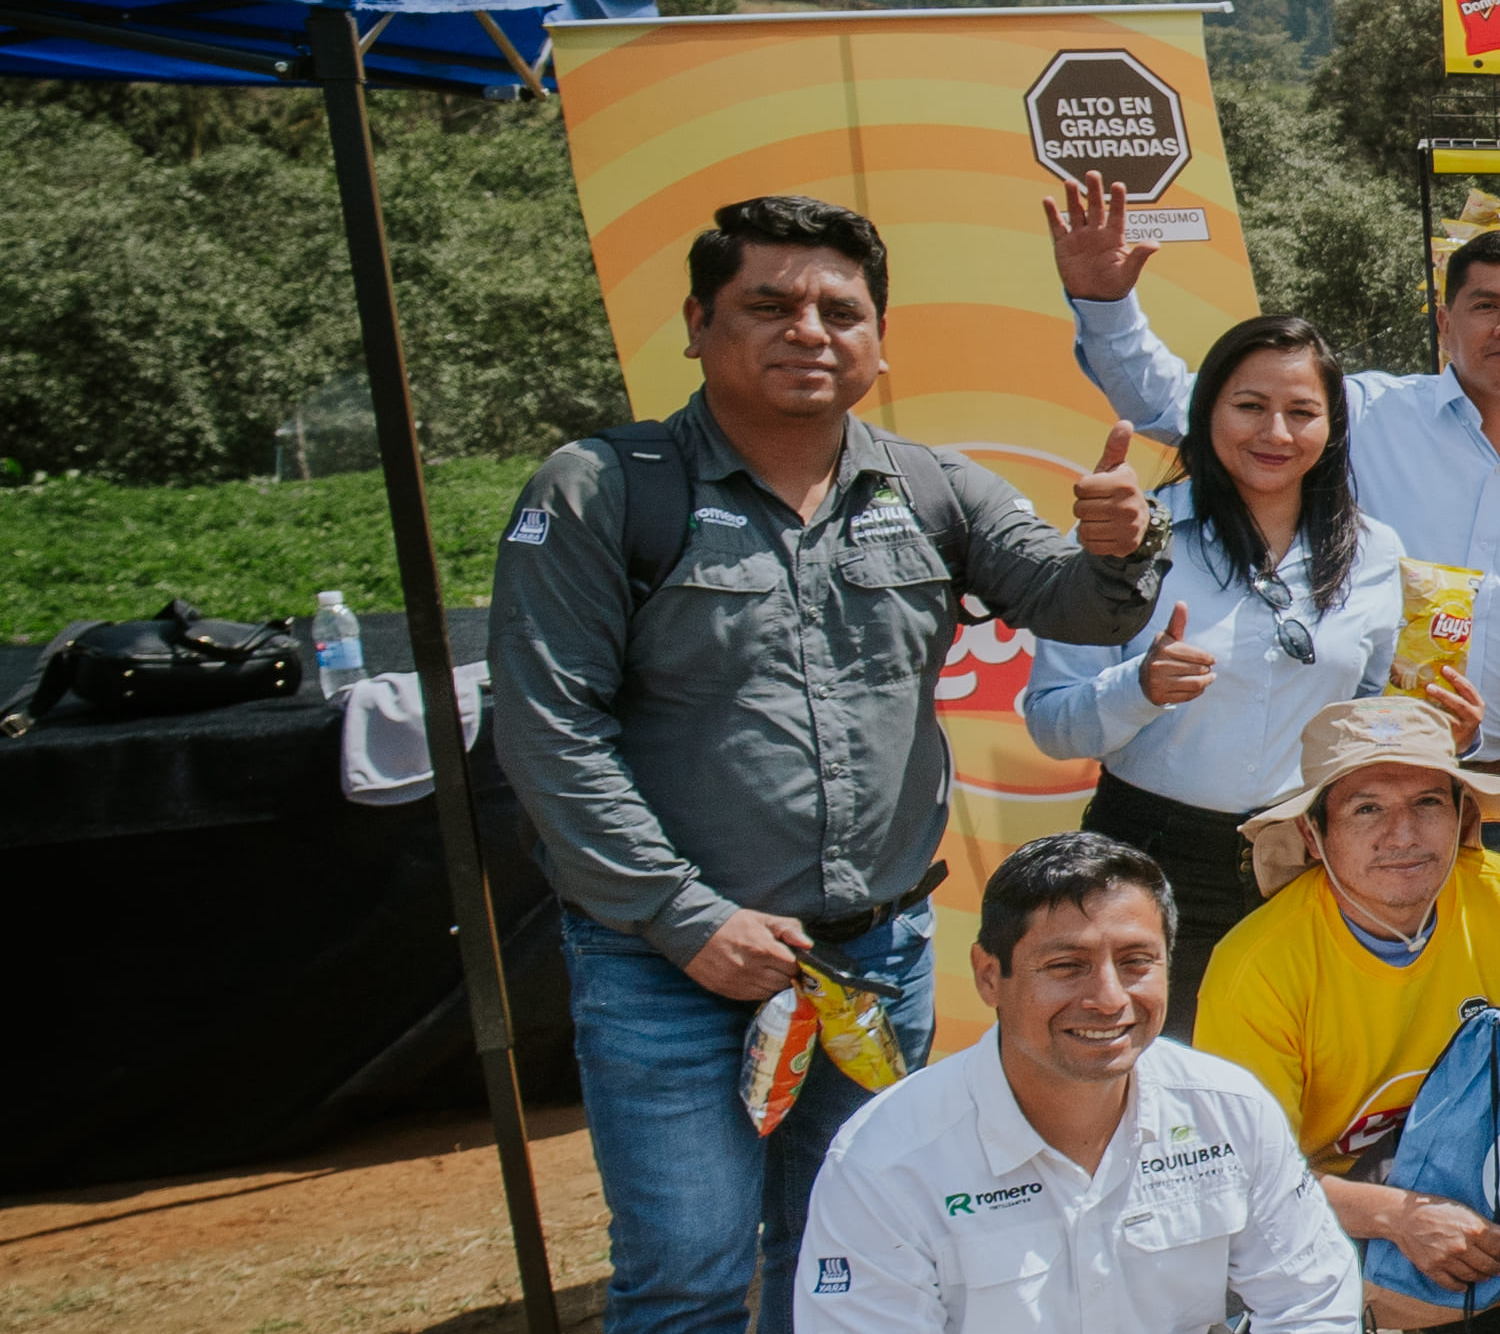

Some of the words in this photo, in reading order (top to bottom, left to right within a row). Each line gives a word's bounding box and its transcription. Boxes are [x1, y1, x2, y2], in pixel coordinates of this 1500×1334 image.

[1057, 98, 1115, 117] ALTO
[1119, 97, 1153, 115] EN
[1060, 117, 1157, 138] GRASAS
[1045, 138, 1180, 159] SATURADAS
[1128, 211, 1200, 225] CONSUMO
[1124, 228, 1163, 240] ESIVO
[1434, 612, 1471, 642] Lay's
[1140, 1142, 1236, 1175] EQUILIBRA
[976, 1182, 1043, 1206] romero
[818, 1283, 848, 1294] YARA
